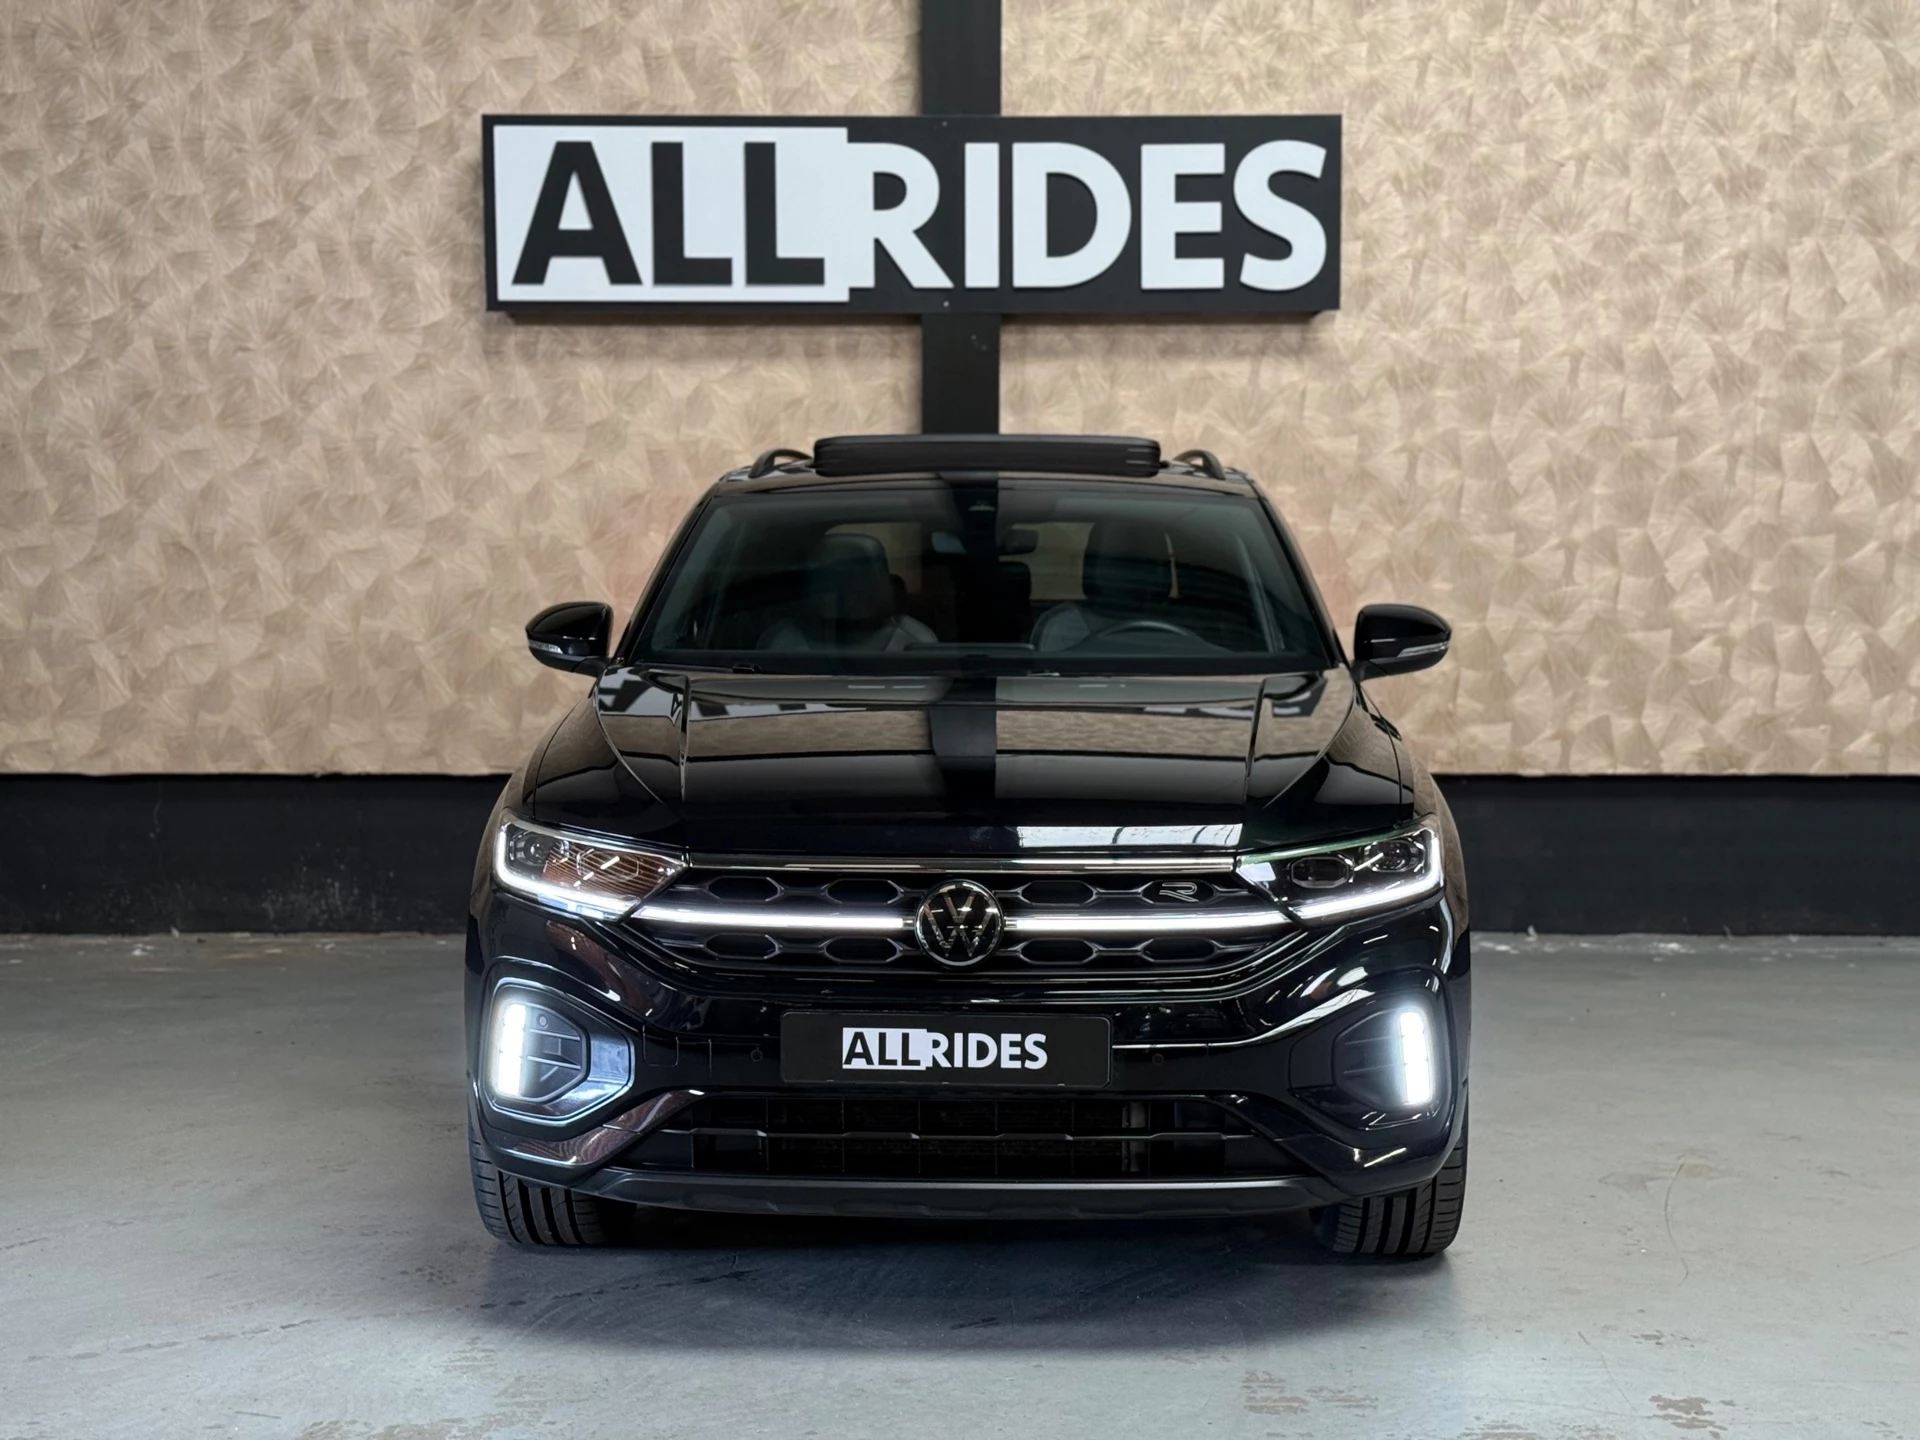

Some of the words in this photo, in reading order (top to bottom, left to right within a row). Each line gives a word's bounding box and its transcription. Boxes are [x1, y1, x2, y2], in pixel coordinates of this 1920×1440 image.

[511, 139, 1327, 291] ALLRIDES
[1158, 881, 1199, 902] R
[919, 882, 1000, 963] VW
[843, 1031, 1048, 1070] ALLRIDES
